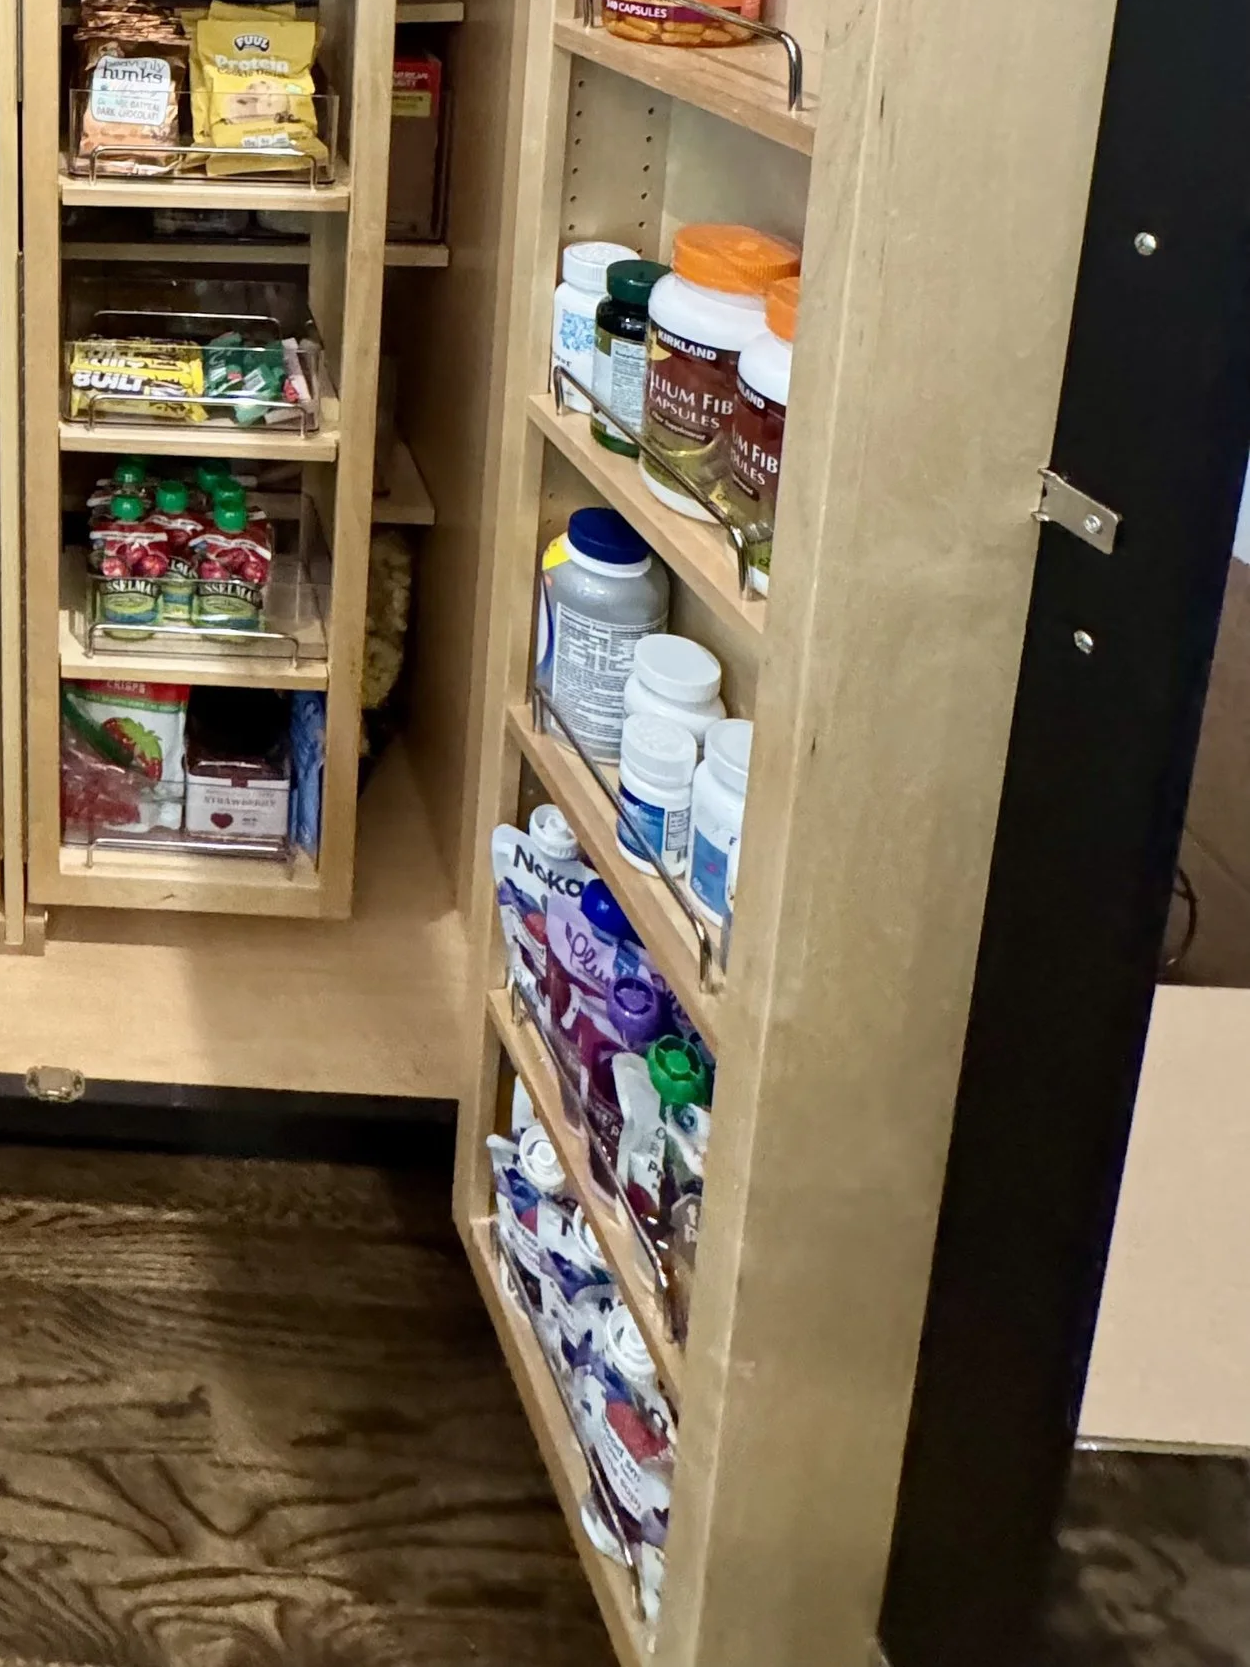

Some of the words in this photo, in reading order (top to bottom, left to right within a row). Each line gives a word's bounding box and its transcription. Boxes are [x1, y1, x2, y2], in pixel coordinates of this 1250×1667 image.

[619, 2, 667, 18] CAPSULES
[101, 66, 163, 84] hunks
[657, 329, 717, 361] KIRKLAND
[73, 370, 145, 392] BUILT
[703, 393, 734, 415] FIB
[752, 444, 778, 474] FIB
[514, 844, 585, 897] Noka
